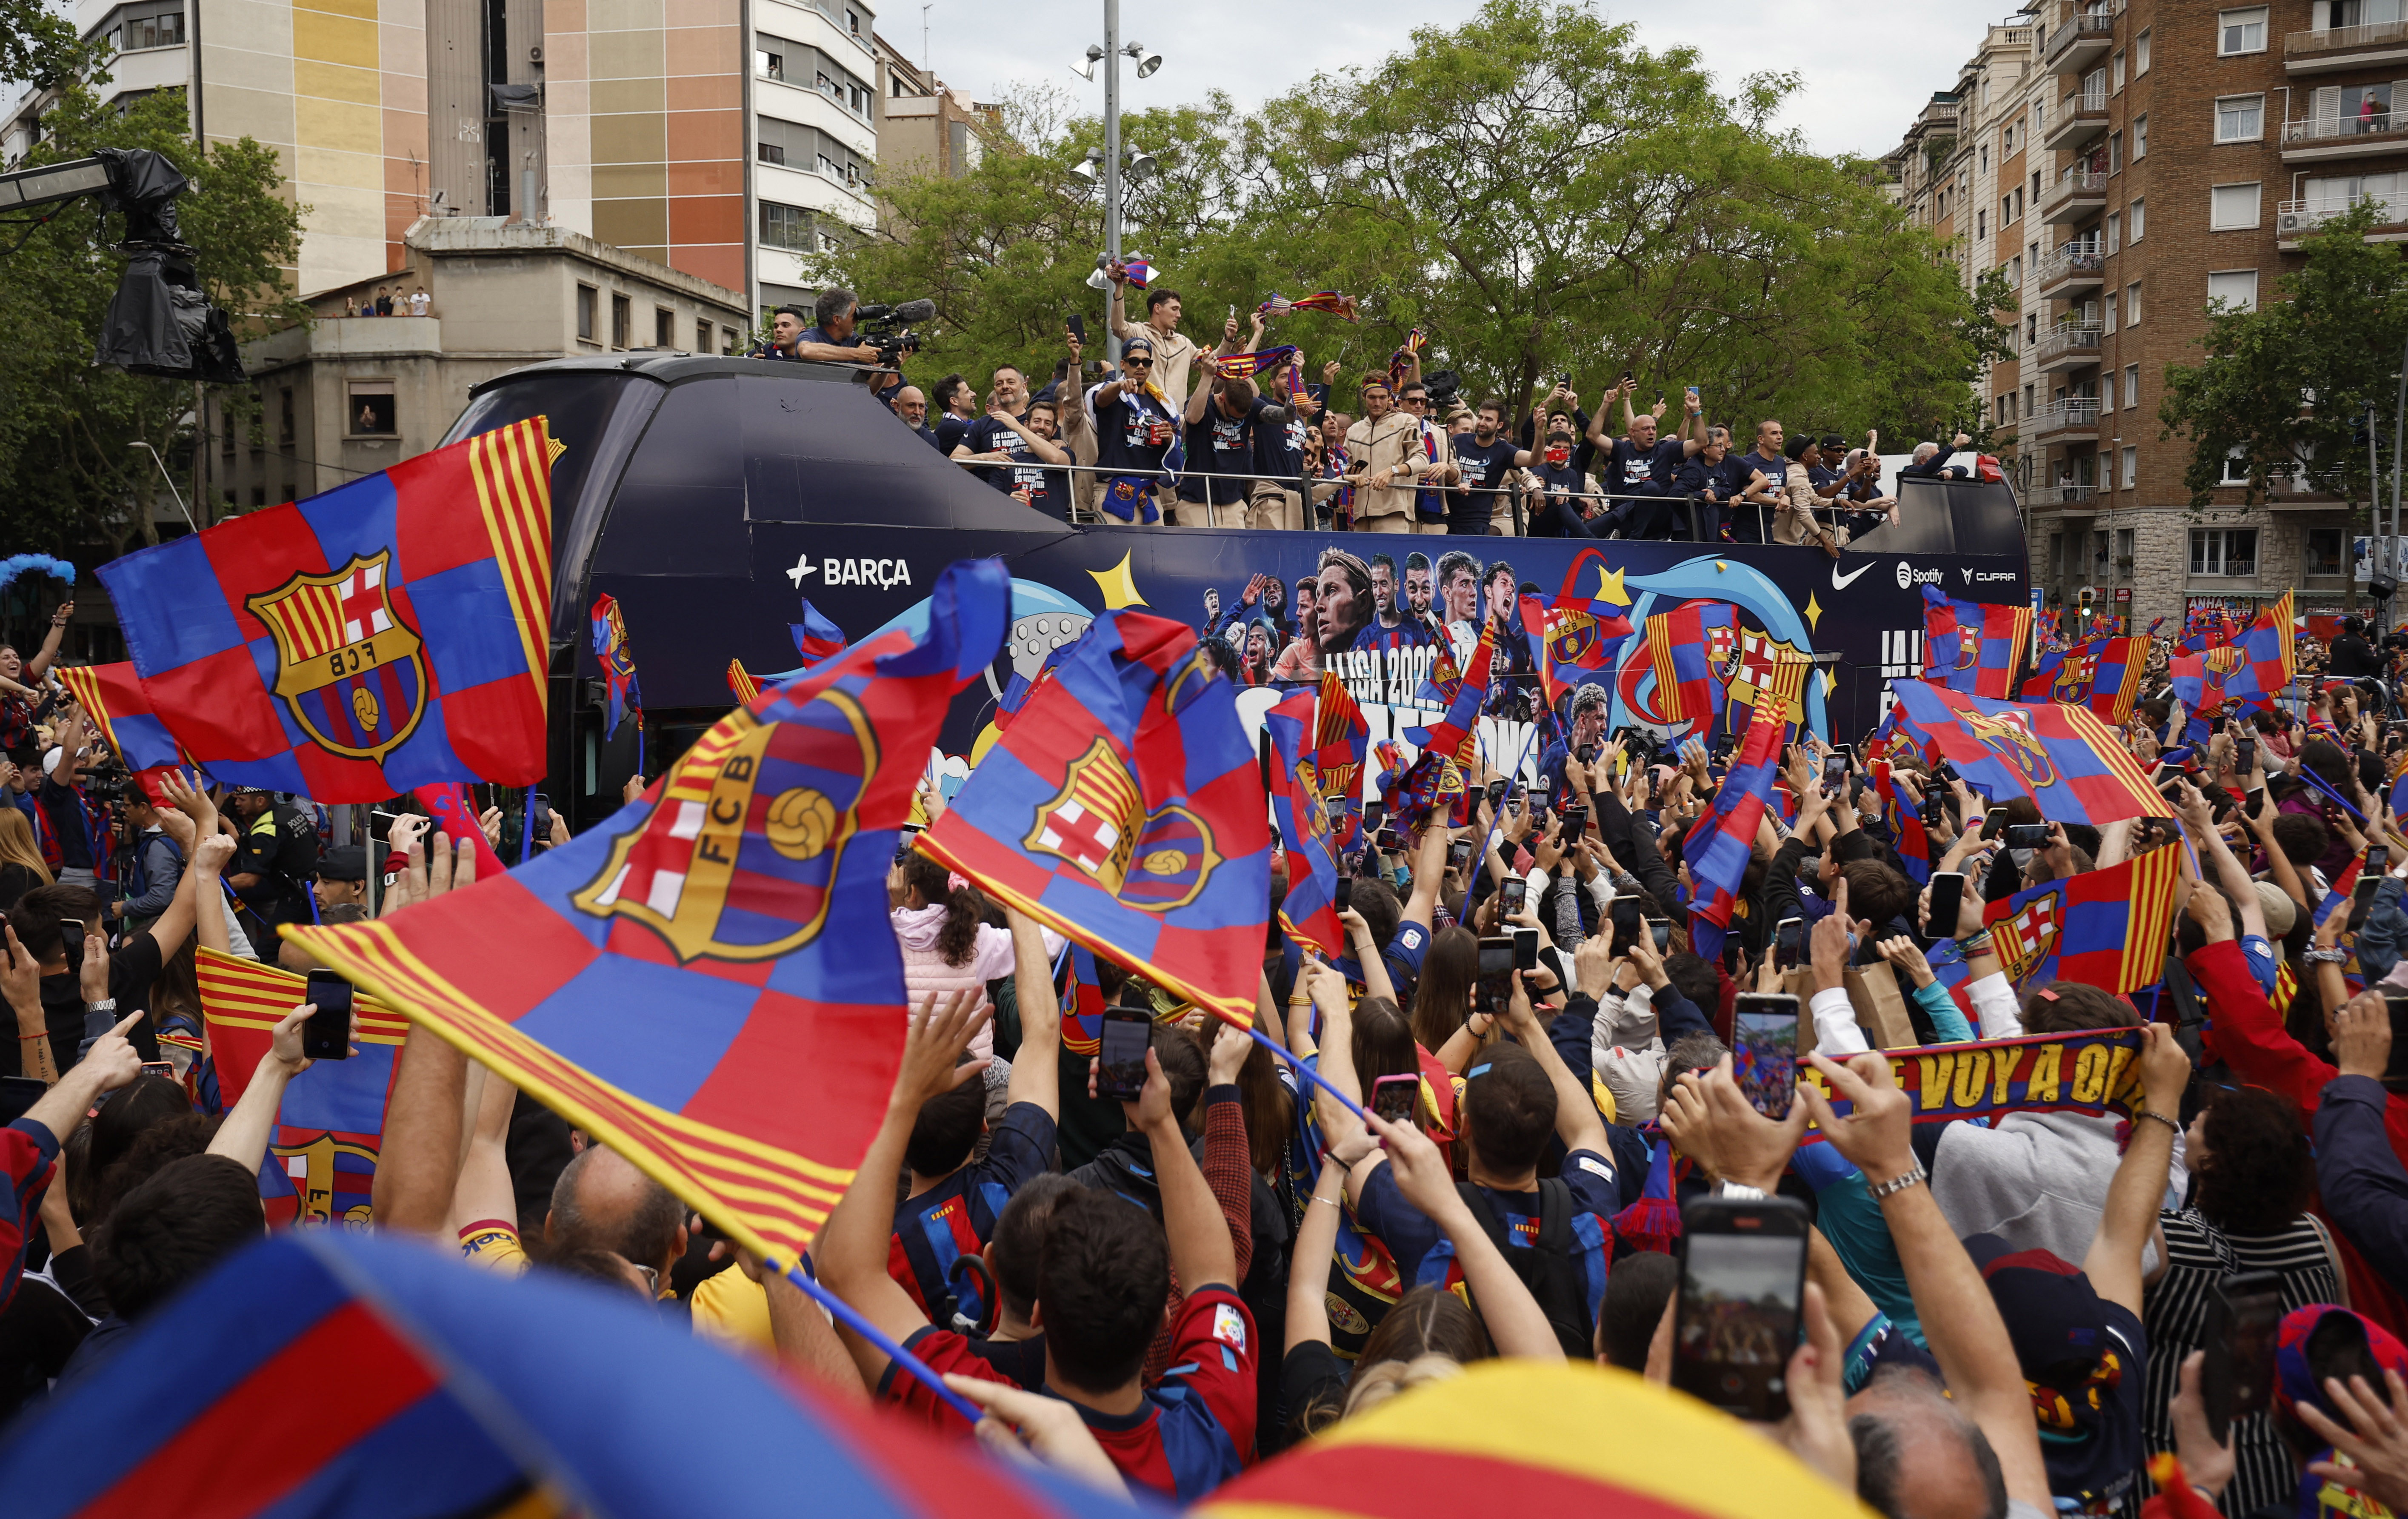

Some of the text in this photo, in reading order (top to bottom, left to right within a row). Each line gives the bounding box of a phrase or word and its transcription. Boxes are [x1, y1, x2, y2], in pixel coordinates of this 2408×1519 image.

[992, 439, 1001, 448] ÉS
[1014, 475, 1023, 483] ÉS
[824, 558, 911, 591] BARÇA
[1913, 568, 1942, 585] Spotify
[1976, 573, 2016, 581] CUPRA
[1557, 622, 1578, 637] FCB
[699, 754, 757, 866] FCB
[1110, 824, 1133, 877] FCB
[1915, 1044, 2024, 1110] VOY
[2024, 1044, 2063, 1103] A
